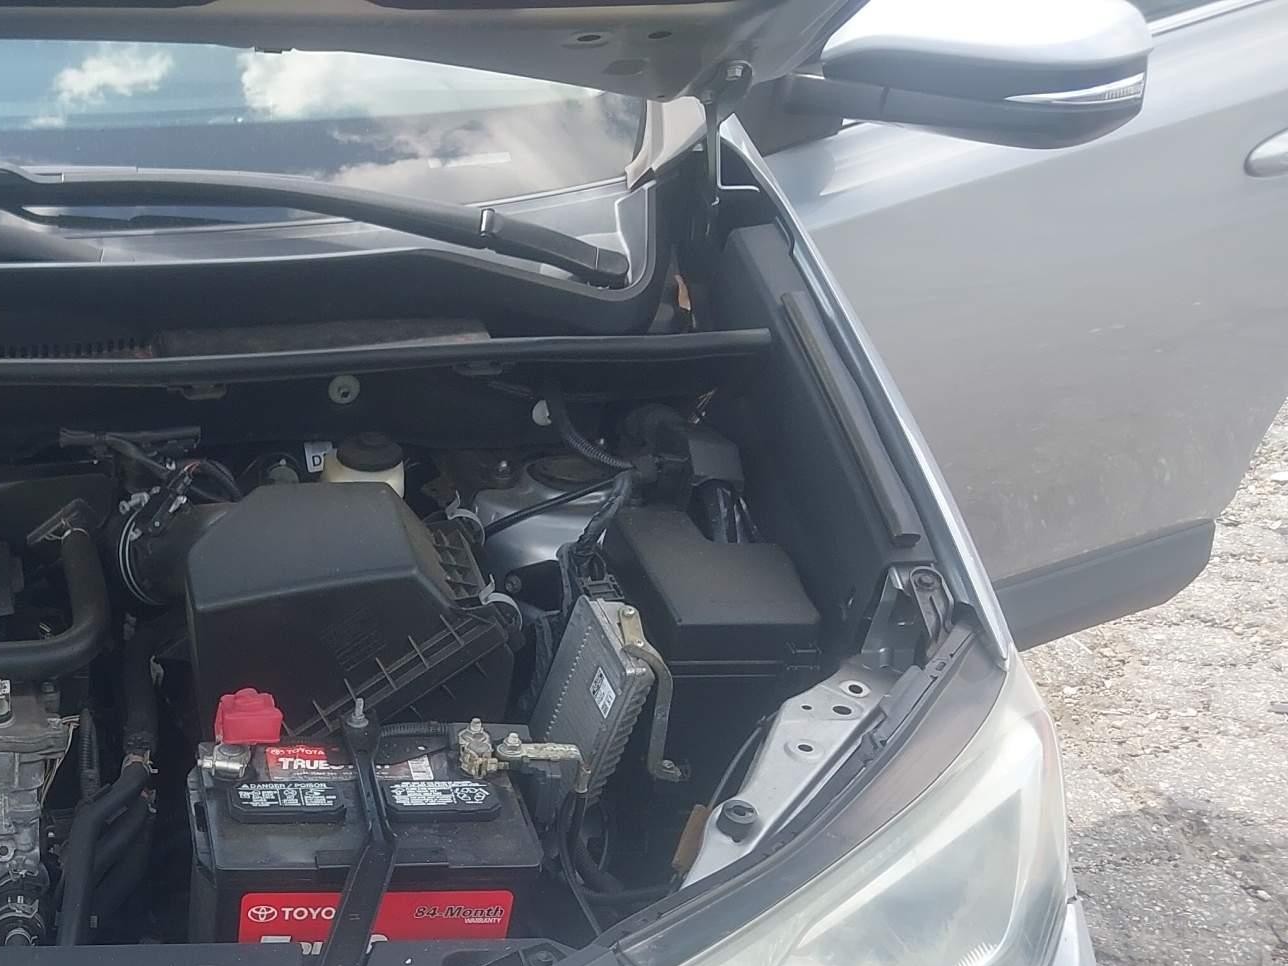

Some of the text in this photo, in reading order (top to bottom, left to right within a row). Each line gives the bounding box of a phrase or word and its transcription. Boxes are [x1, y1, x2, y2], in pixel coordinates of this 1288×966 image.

[286, 747, 325, 755] TOYOTA
[281, 907, 336, 920] TOYO
[414, 905, 505, 918] 84-Month
